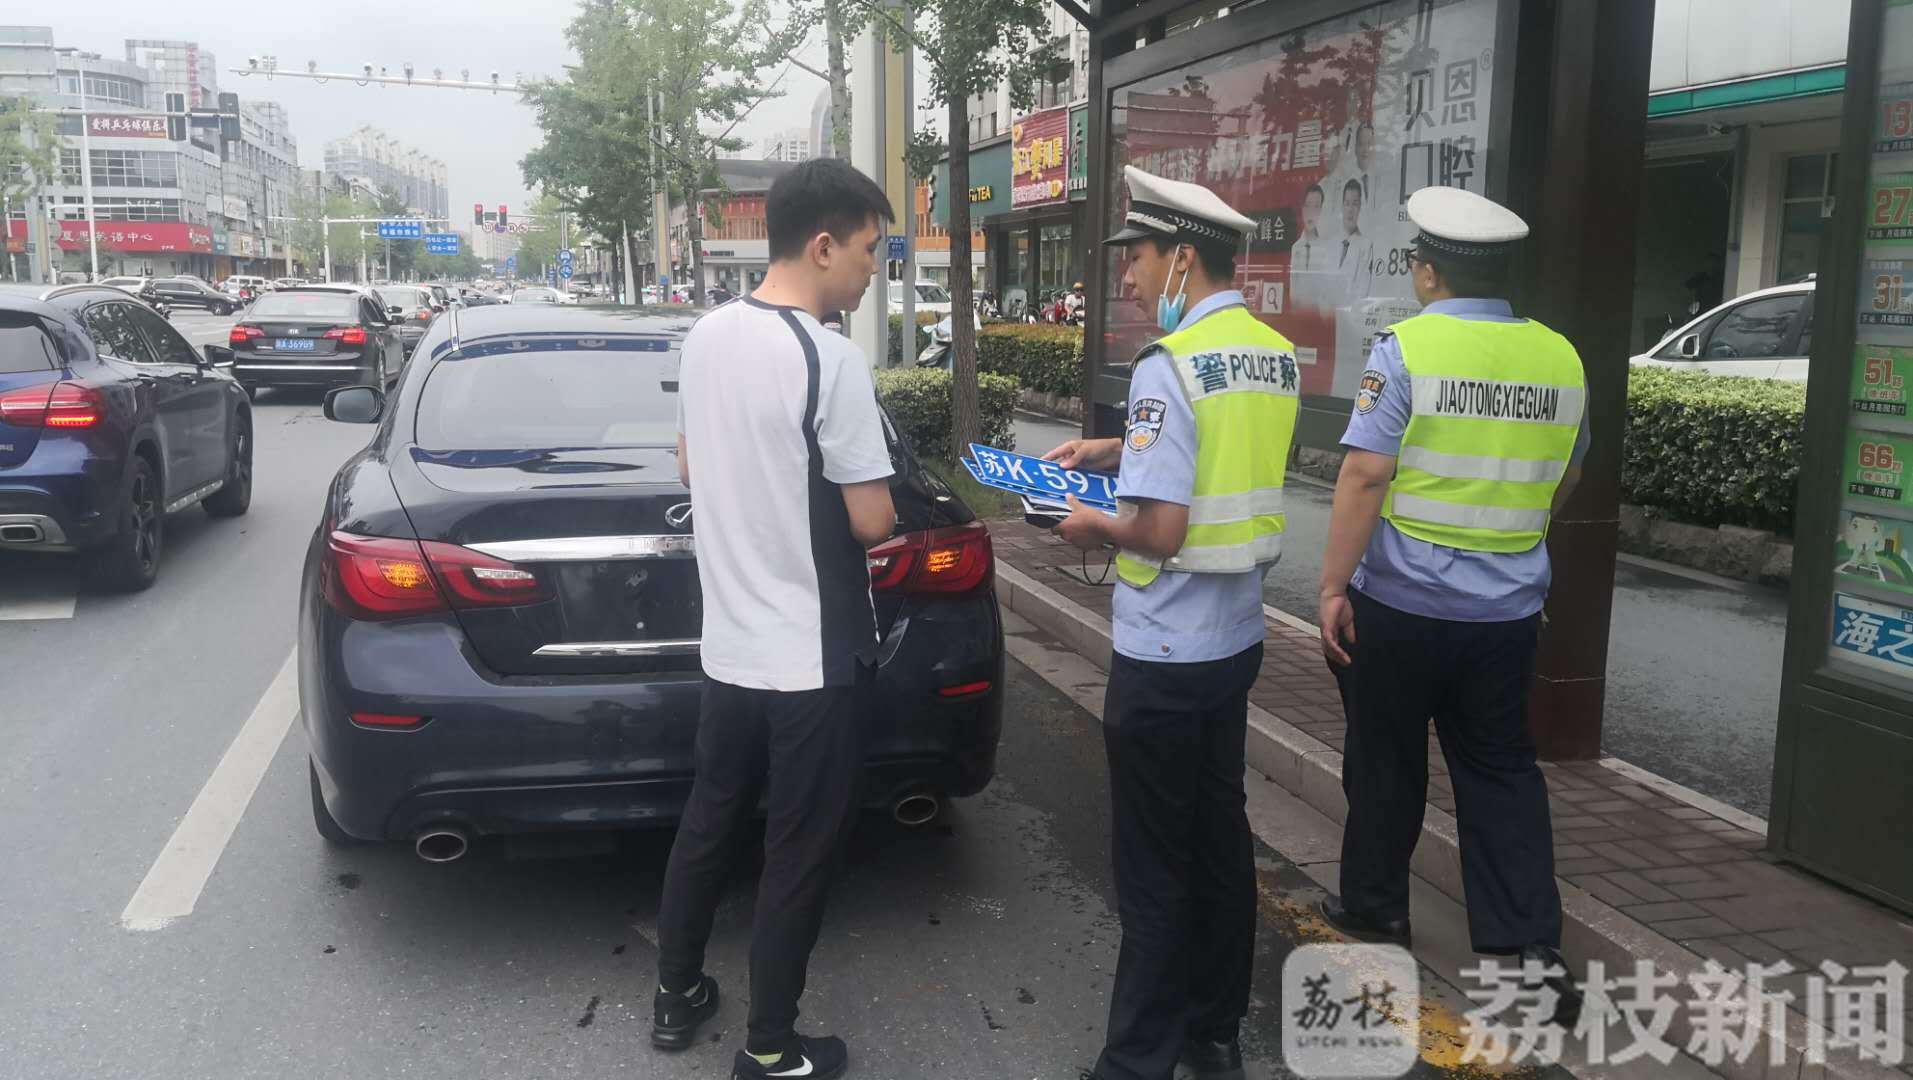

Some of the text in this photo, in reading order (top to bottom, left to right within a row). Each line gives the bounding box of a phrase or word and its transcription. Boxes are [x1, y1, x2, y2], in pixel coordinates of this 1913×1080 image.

[1192, 353, 1297, 393] 警 POLICE 察
[1436, 380, 1559, 421] JIAOTONGXIEGUAN
[978, 451, 1118, 499] 苏K·597
[1835, 612, 1913, 668] 海之
